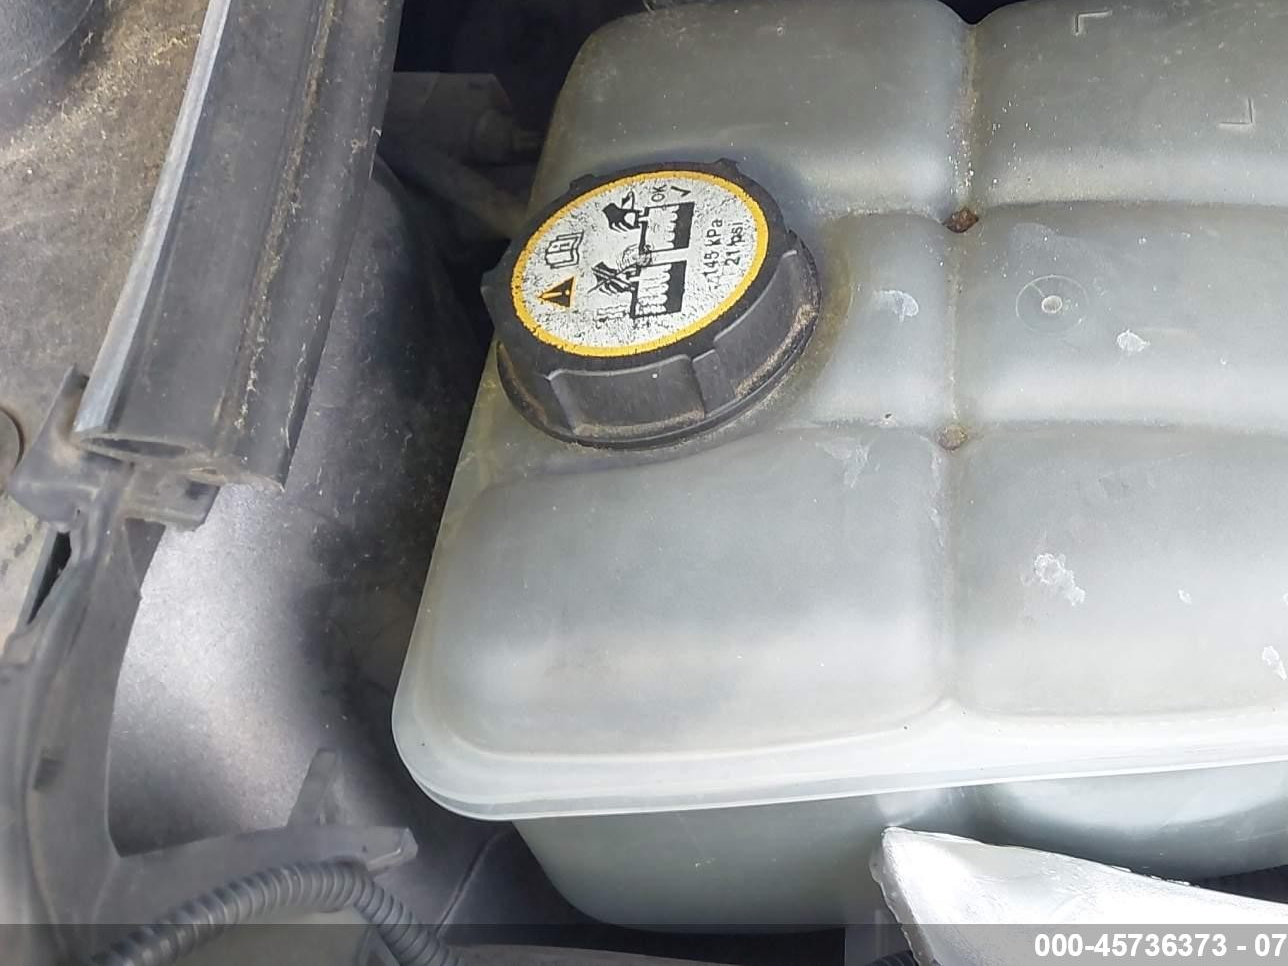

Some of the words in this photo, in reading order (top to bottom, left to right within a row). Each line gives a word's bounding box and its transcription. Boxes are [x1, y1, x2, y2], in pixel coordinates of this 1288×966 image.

[651, 184, 667, 203] OK
[705, 219, 723, 246] kPa
[725, 250, 741, 266] 21
